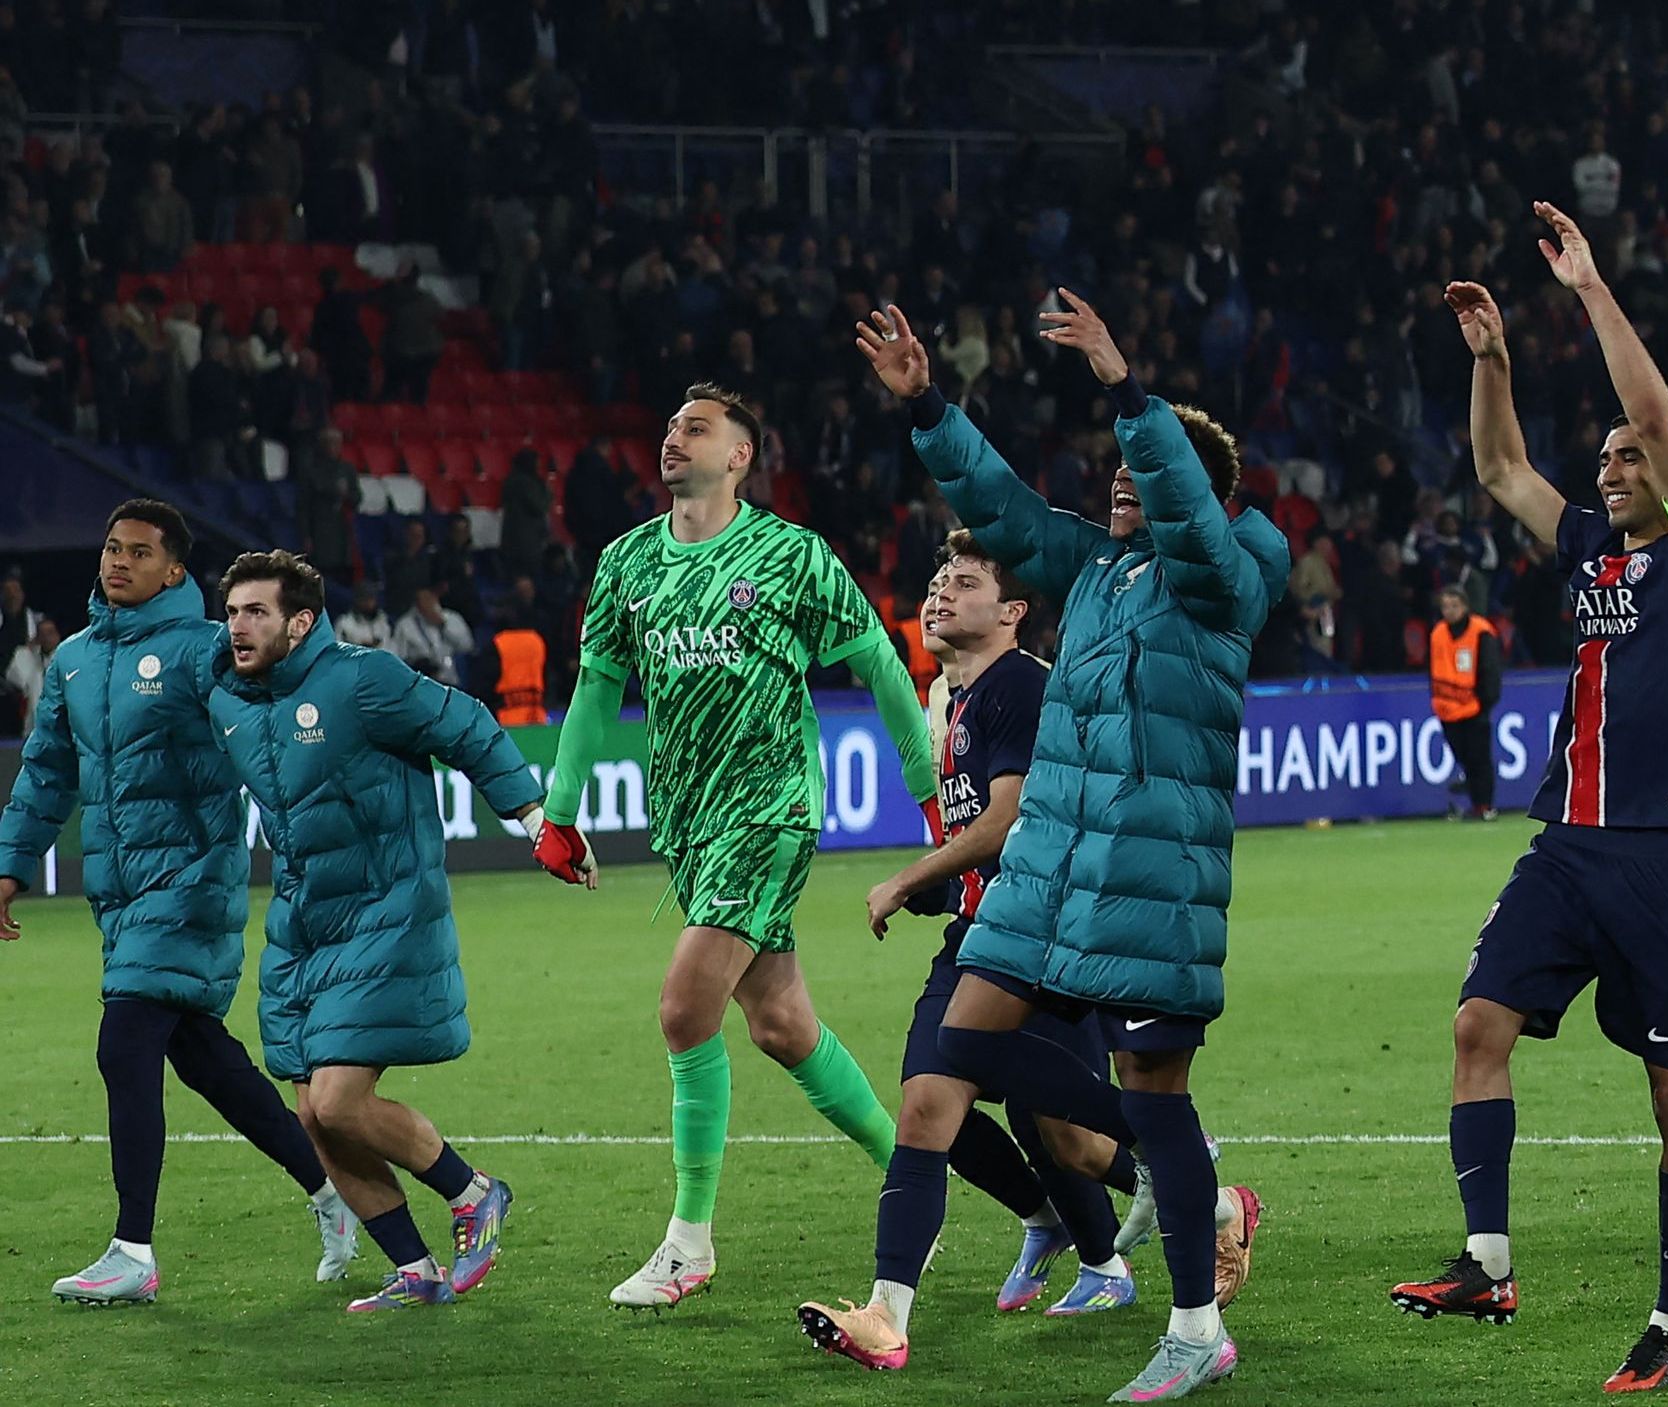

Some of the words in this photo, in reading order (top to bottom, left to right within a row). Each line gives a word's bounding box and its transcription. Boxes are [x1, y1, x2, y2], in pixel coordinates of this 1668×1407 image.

[1568, 585, 1640, 618] ATAR
[645, 625, 740, 659] QATAR
[669, 649, 741, 670] AIRWAYS
[131, 681, 163, 692] QATAR
[293, 728, 325, 742] QATAR
[1237, 710, 1528, 795] HAMPIOS
[940, 772, 978, 806] ATAR
